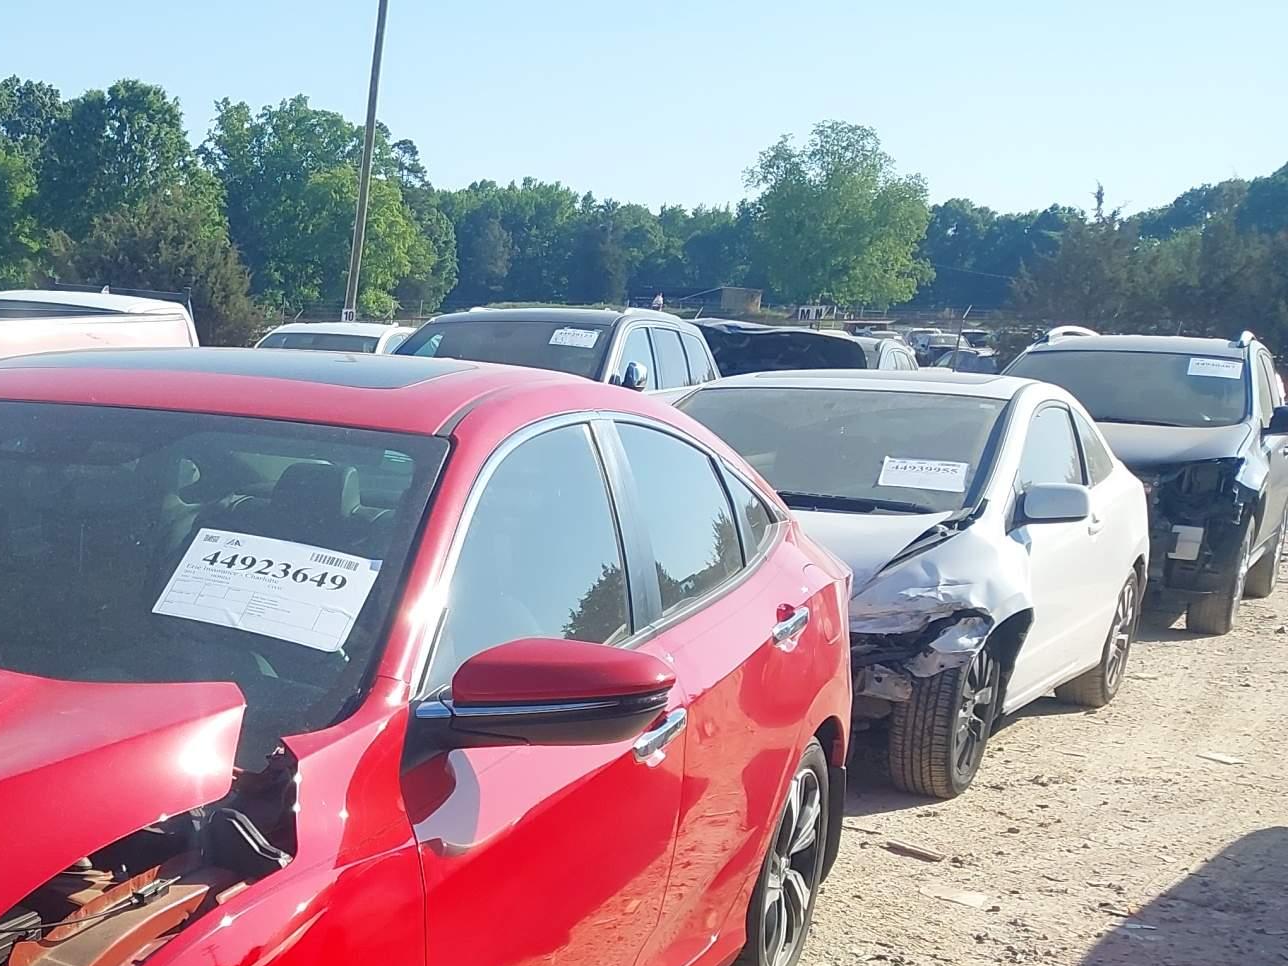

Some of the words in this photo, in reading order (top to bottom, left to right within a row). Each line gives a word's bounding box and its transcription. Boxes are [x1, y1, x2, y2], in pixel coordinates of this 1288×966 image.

[344, 311, 354, 322] 10
[800, 308, 810, 320] M
[202, 550, 348, 591] 44923649
